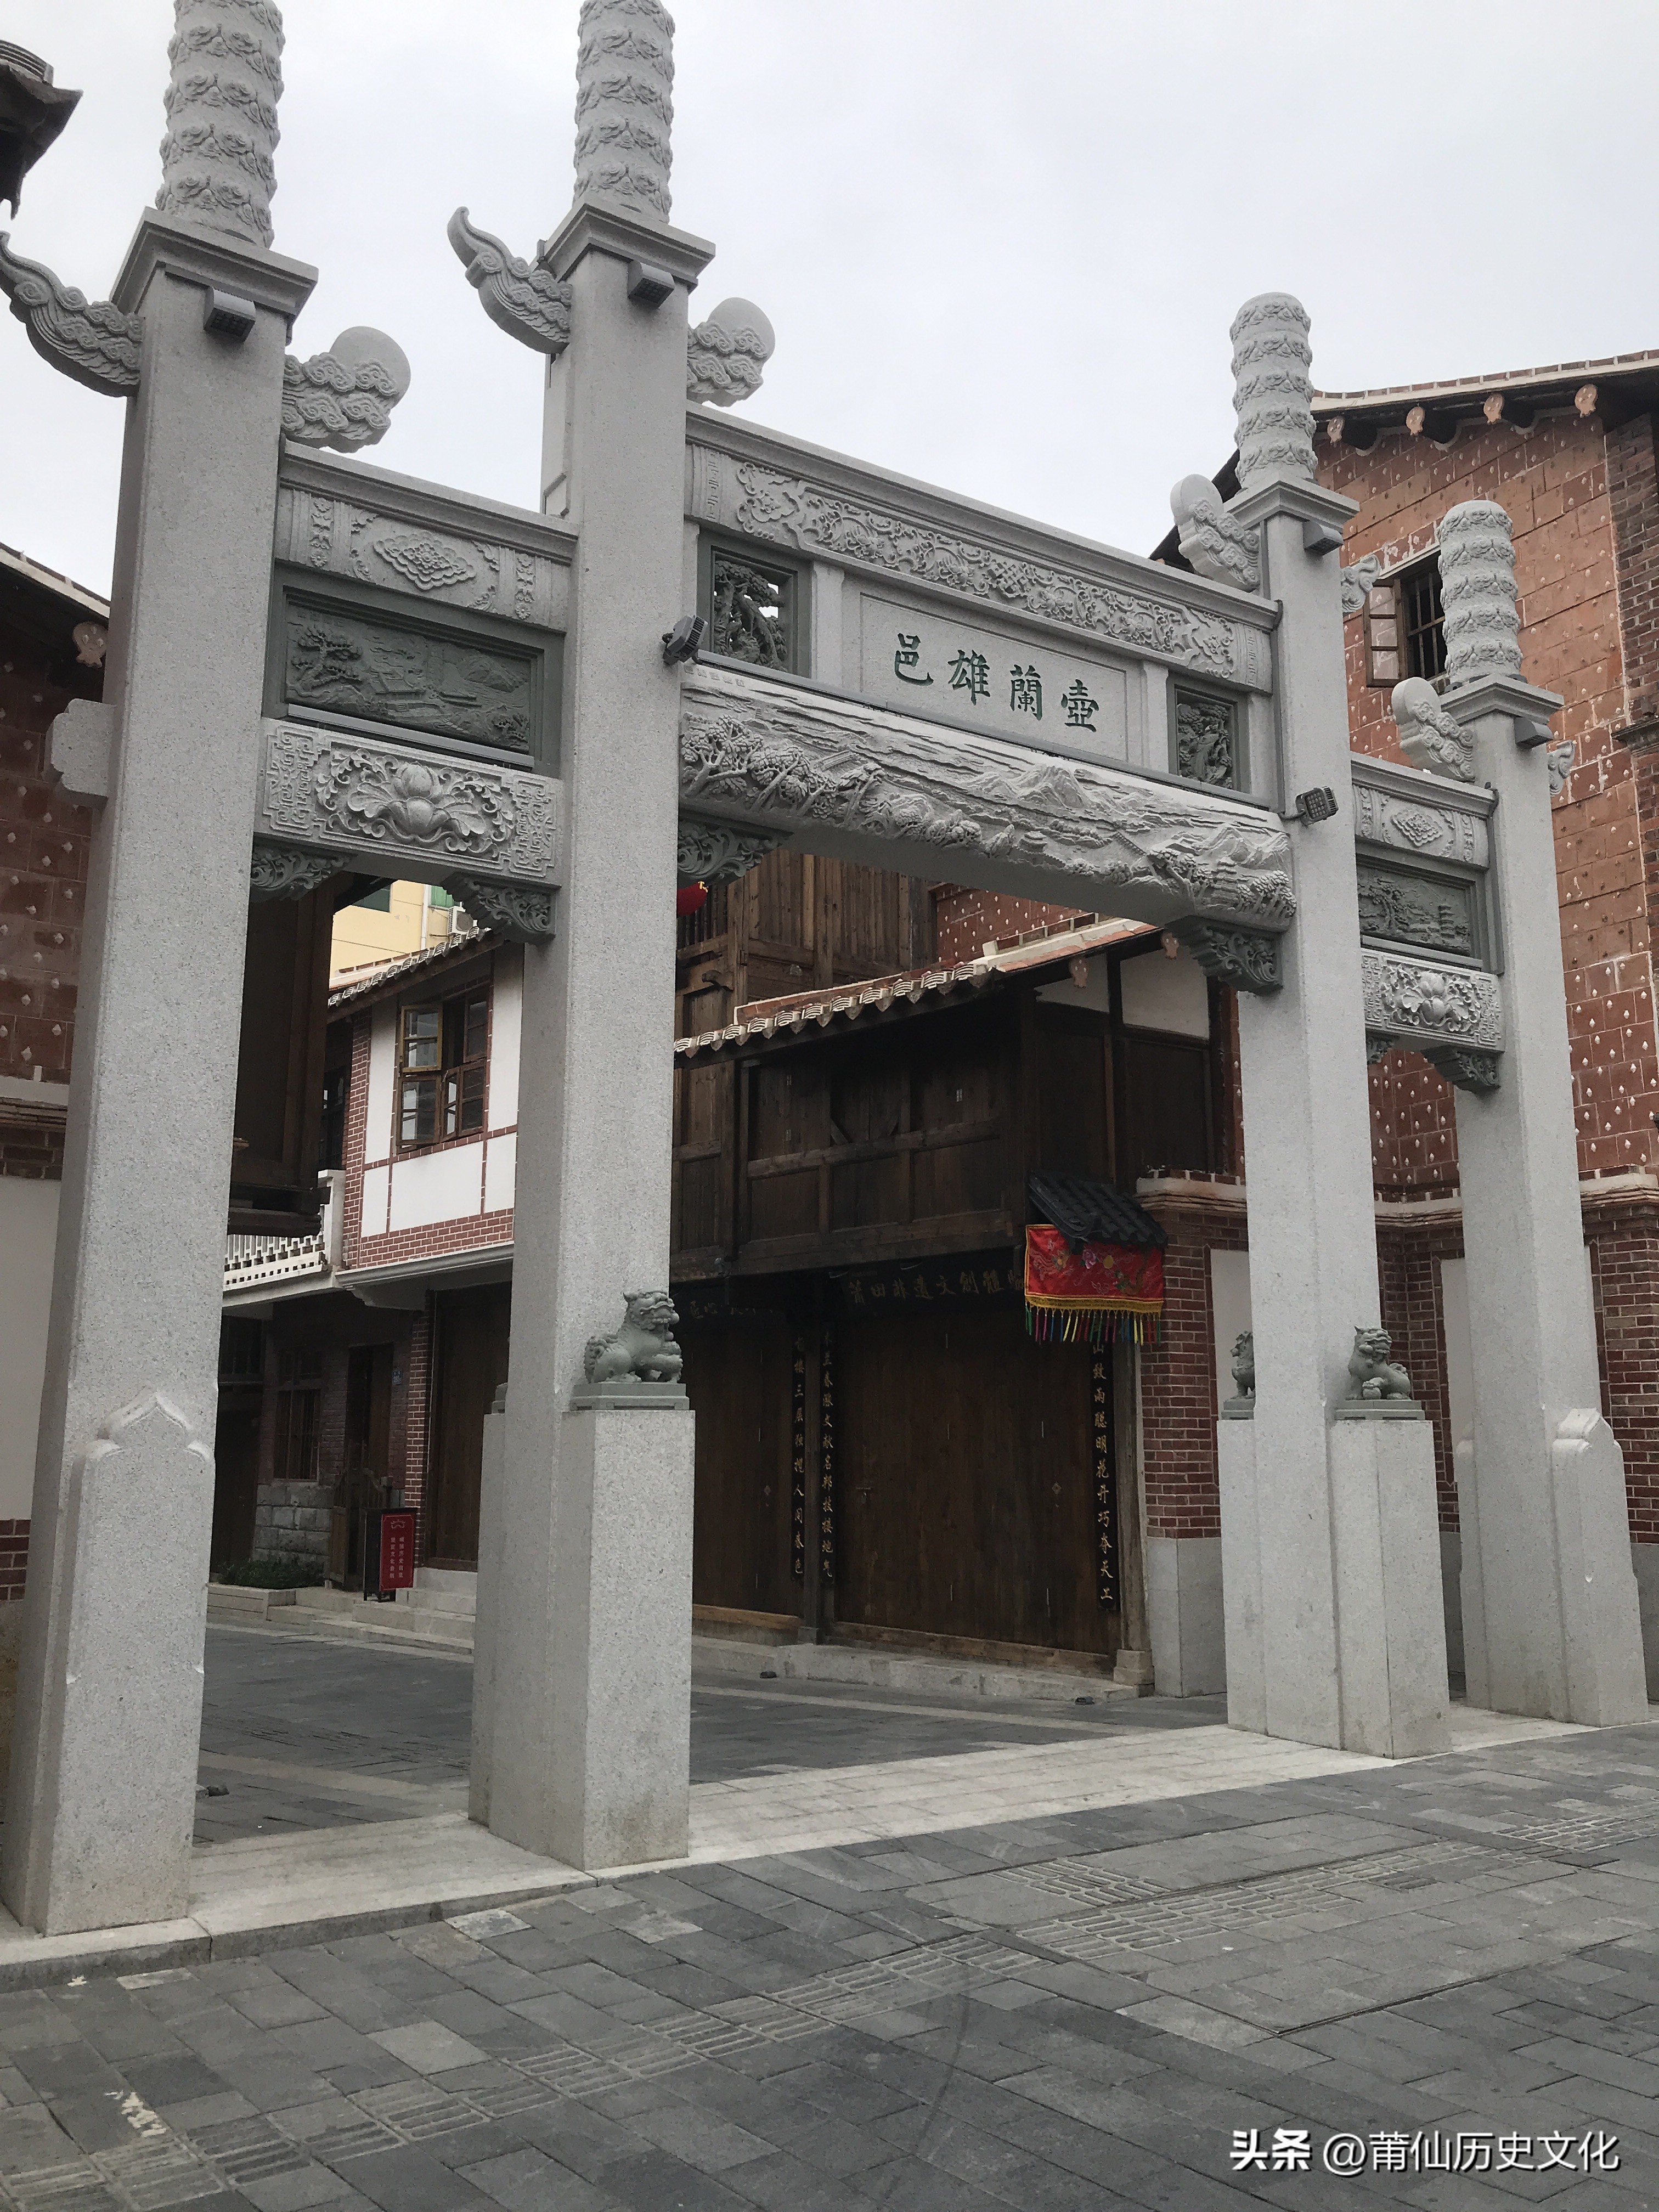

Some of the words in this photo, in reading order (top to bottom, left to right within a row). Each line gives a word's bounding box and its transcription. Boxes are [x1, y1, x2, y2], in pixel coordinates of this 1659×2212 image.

[1093, 1323, 1114, 1600] 山致雨聪明花开巧夺天工
